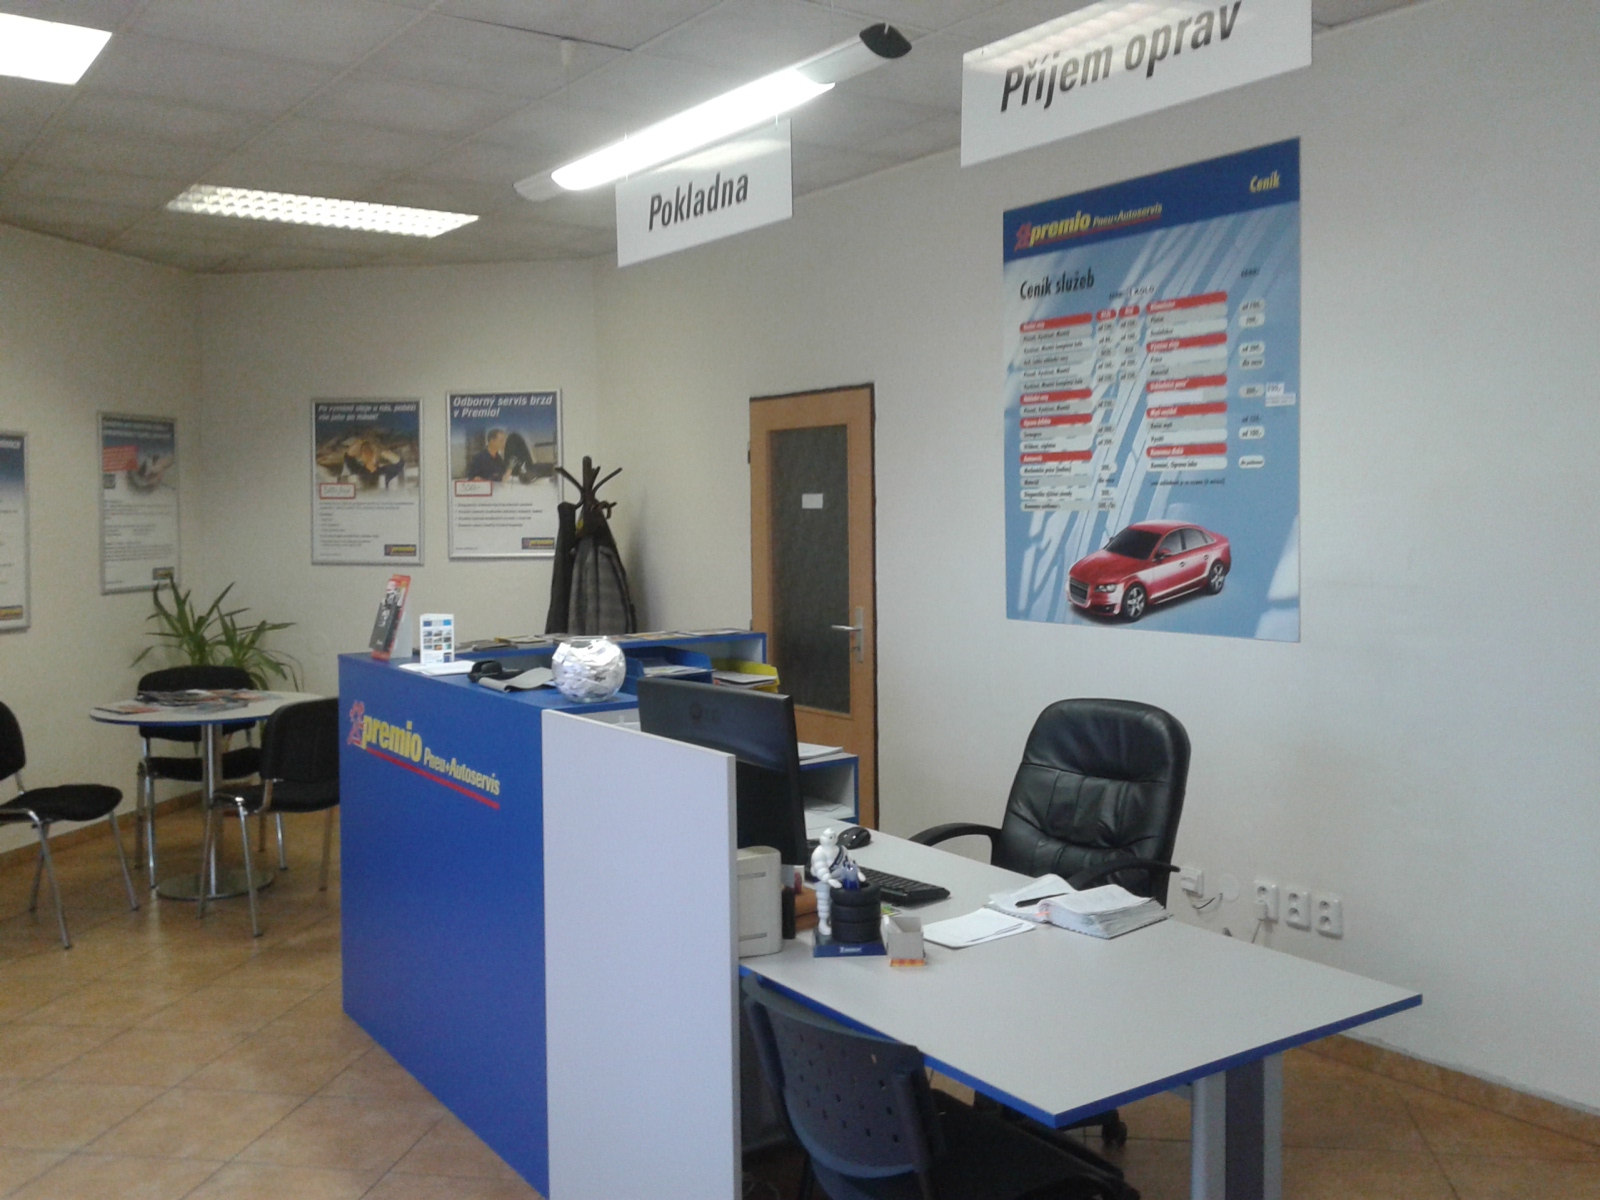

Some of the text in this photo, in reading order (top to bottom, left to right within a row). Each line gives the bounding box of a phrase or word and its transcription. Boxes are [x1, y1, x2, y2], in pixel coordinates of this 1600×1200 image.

[1001, 1, 1242, 113] Příjem oprav
[1250, 170, 1280, 193] Ceník
[648, 171, 749, 232] Pokladna
[1029, 210, 1091, 247] premio
[1020, 266, 1095, 299] Ceník služeb
[453, 394, 553, 408] Odborný servis brzd
[461, 407, 501, 418] Premio!
[362, 714, 500, 796] premio Pneu+Autoservis
